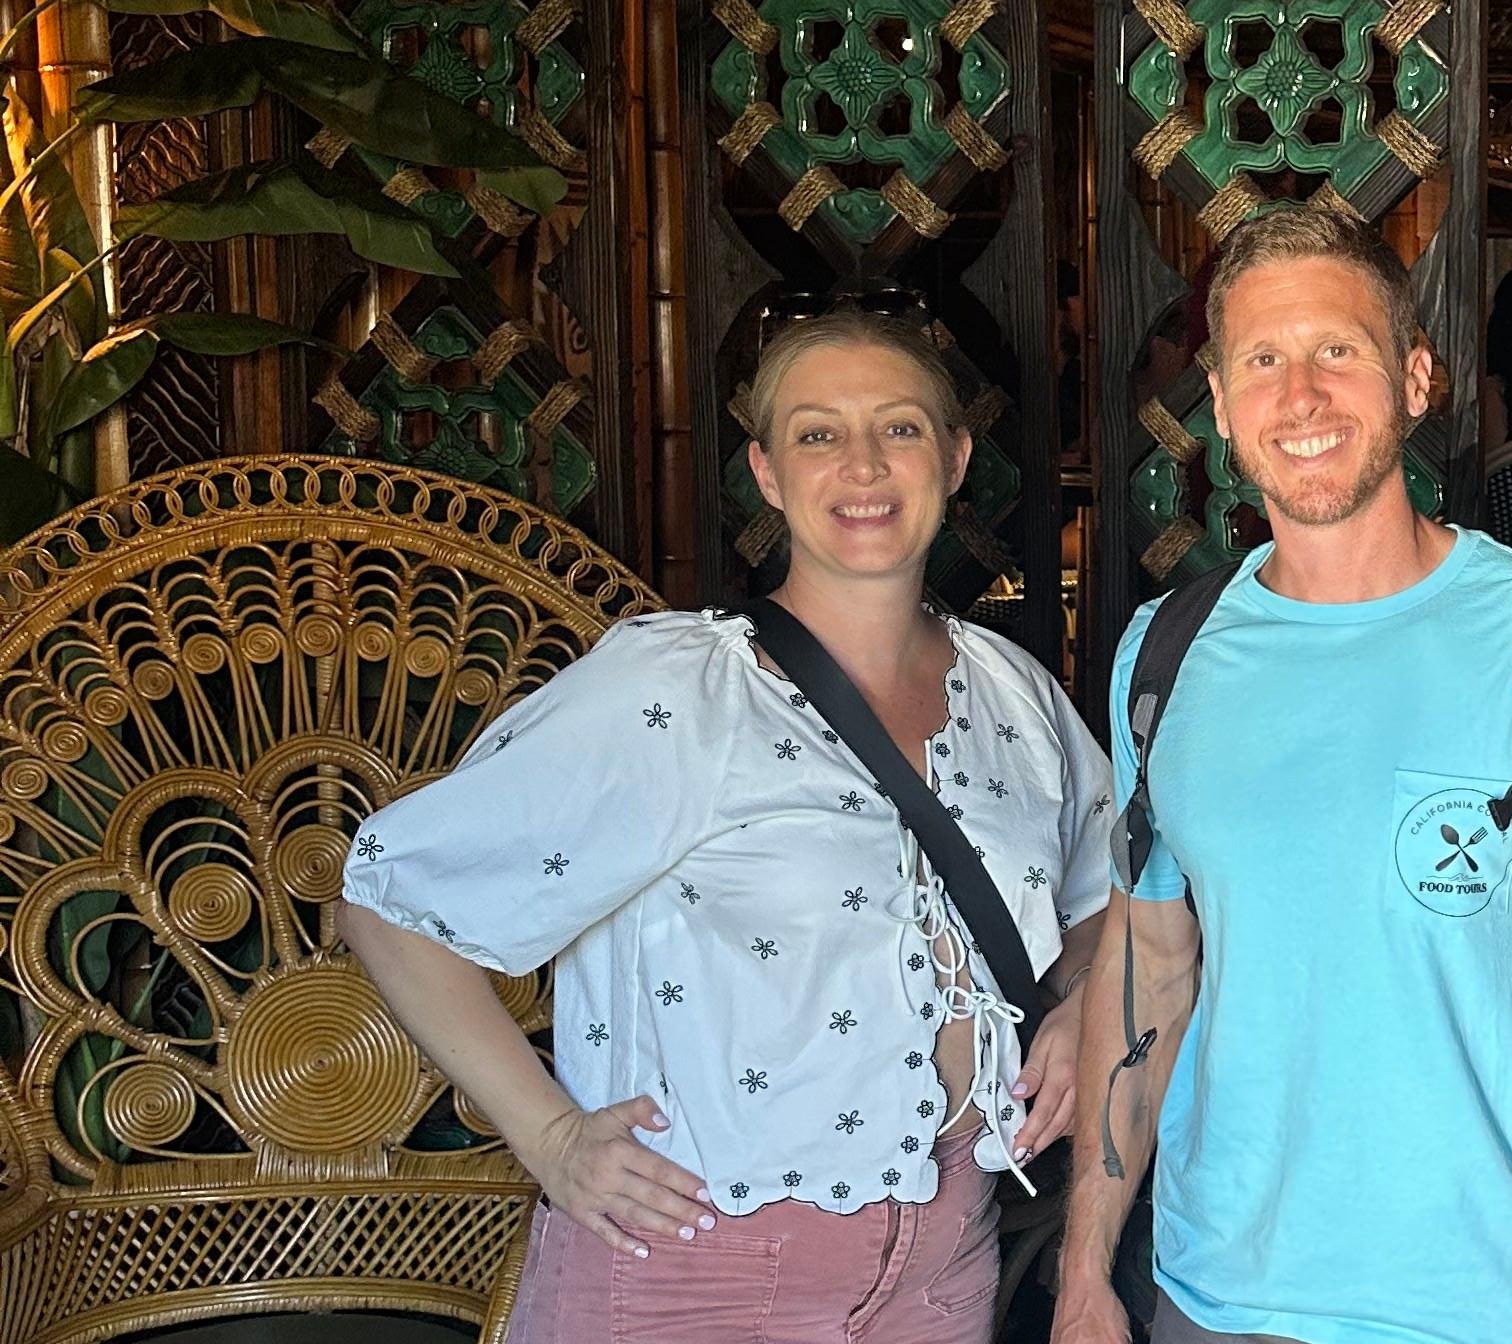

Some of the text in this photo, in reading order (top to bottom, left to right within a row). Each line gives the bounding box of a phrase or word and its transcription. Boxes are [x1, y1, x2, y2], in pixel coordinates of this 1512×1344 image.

[1409, 800, 1474, 835] CALIFORNIA
[1418, 880, 1488, 895] FOOD TOURS
